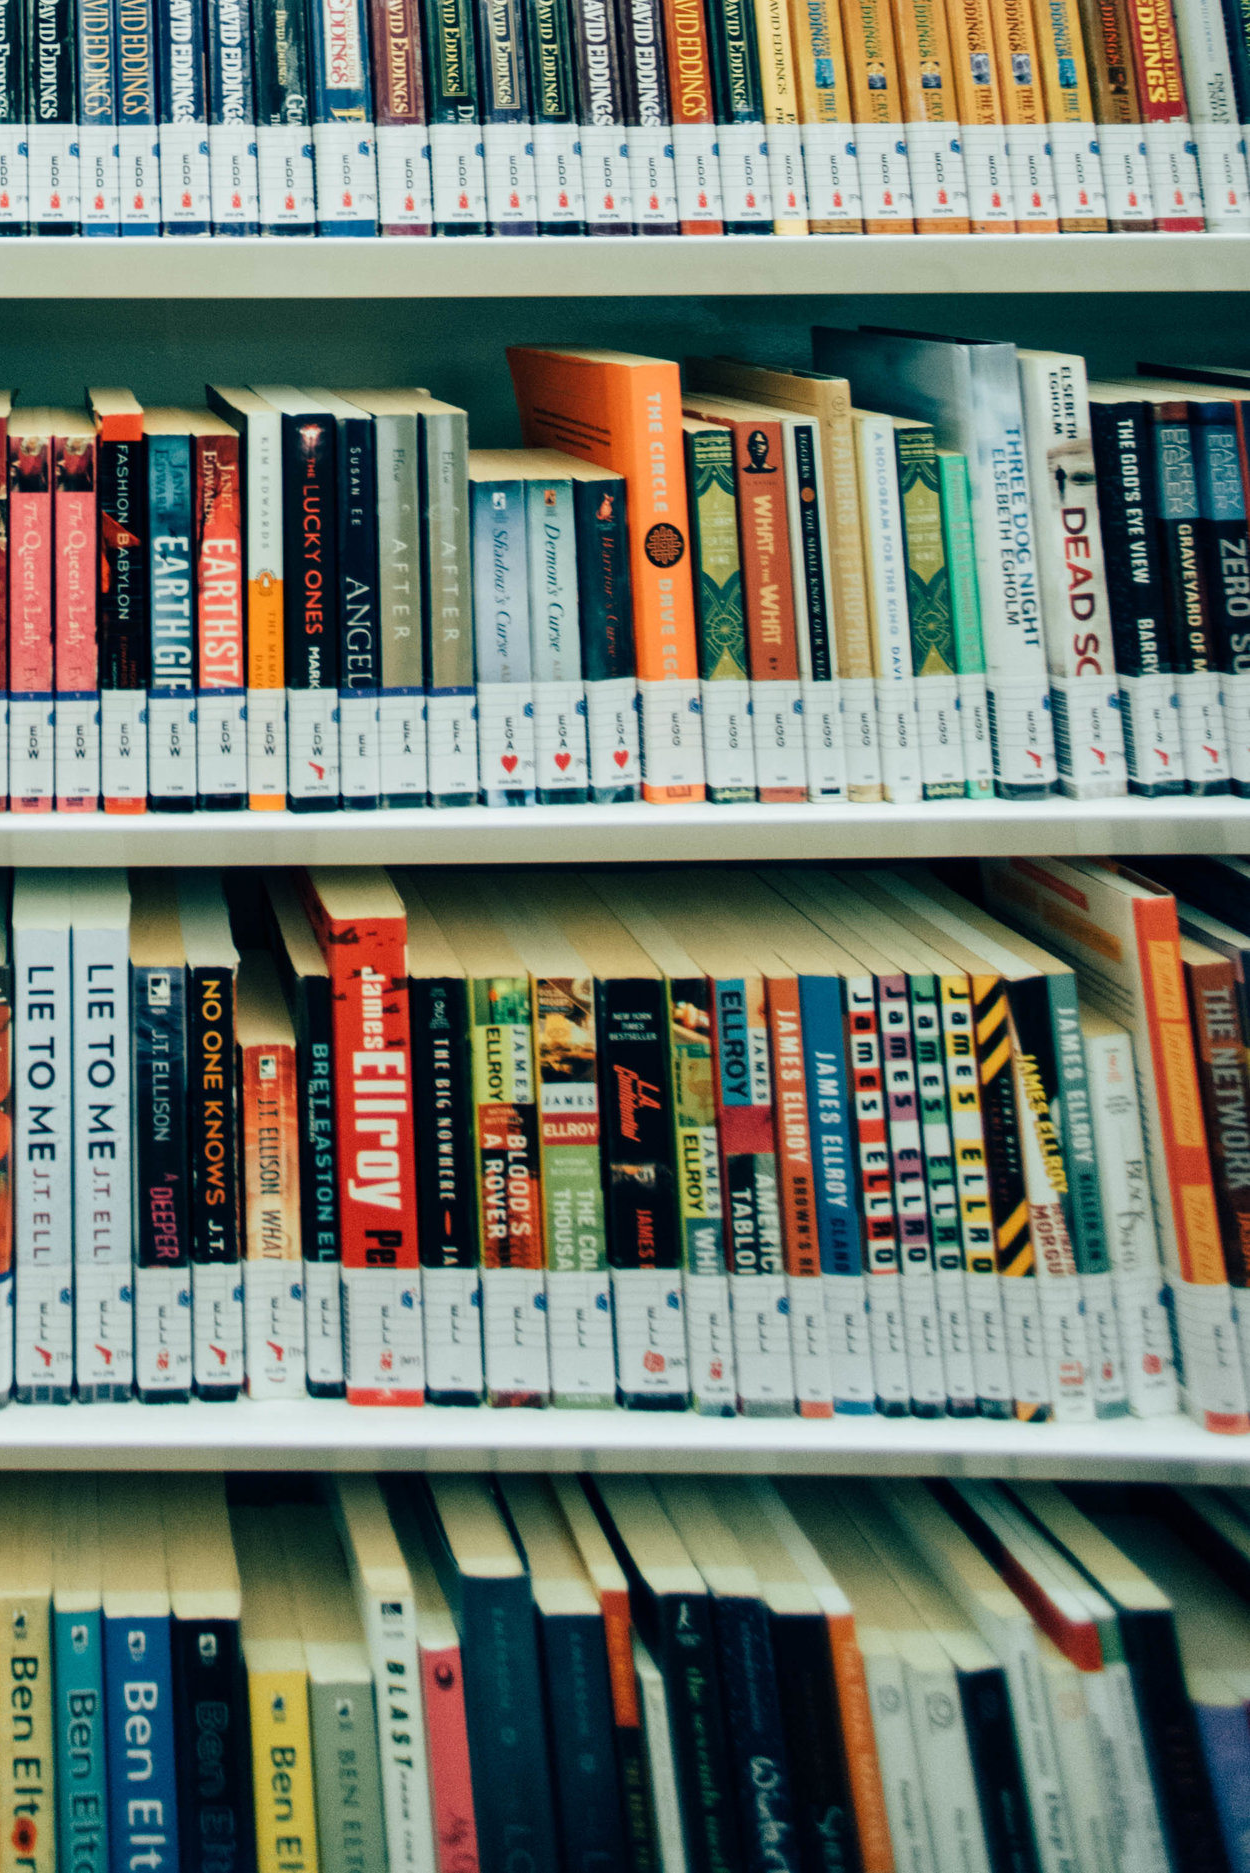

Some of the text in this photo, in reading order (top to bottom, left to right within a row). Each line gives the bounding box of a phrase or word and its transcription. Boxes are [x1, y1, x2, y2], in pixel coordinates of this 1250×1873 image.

[82, 32, 111, 115] EDDINGS
[677, 37, 706, 117] EDDINGS
[116, 444, 129, 620] FASHION BABYLON
[302, 459, 324, 636] THE LUCKY ONES
[1004, 425, 1040, 648] THREE DOG NIGHT
[1116, 418, 1150, 584] THE GOD'S EYE VIEW
[1061, 506, 1096, 620] DEAD
[28, 966, 55, 1162] LIE TO ME
[361, 966, 384, 1050] James
[202, 981, 226, 1206] NO ONE KNOWS
[347, 1052, 406, 1211] Ellroy
[542, 1123, 597, 1137] ELLROY
[543, 1095, 596, 1106] JAMES
[10, 1654, 39, 1742] Ben
[122, 1682, 158, 1780] Ben
